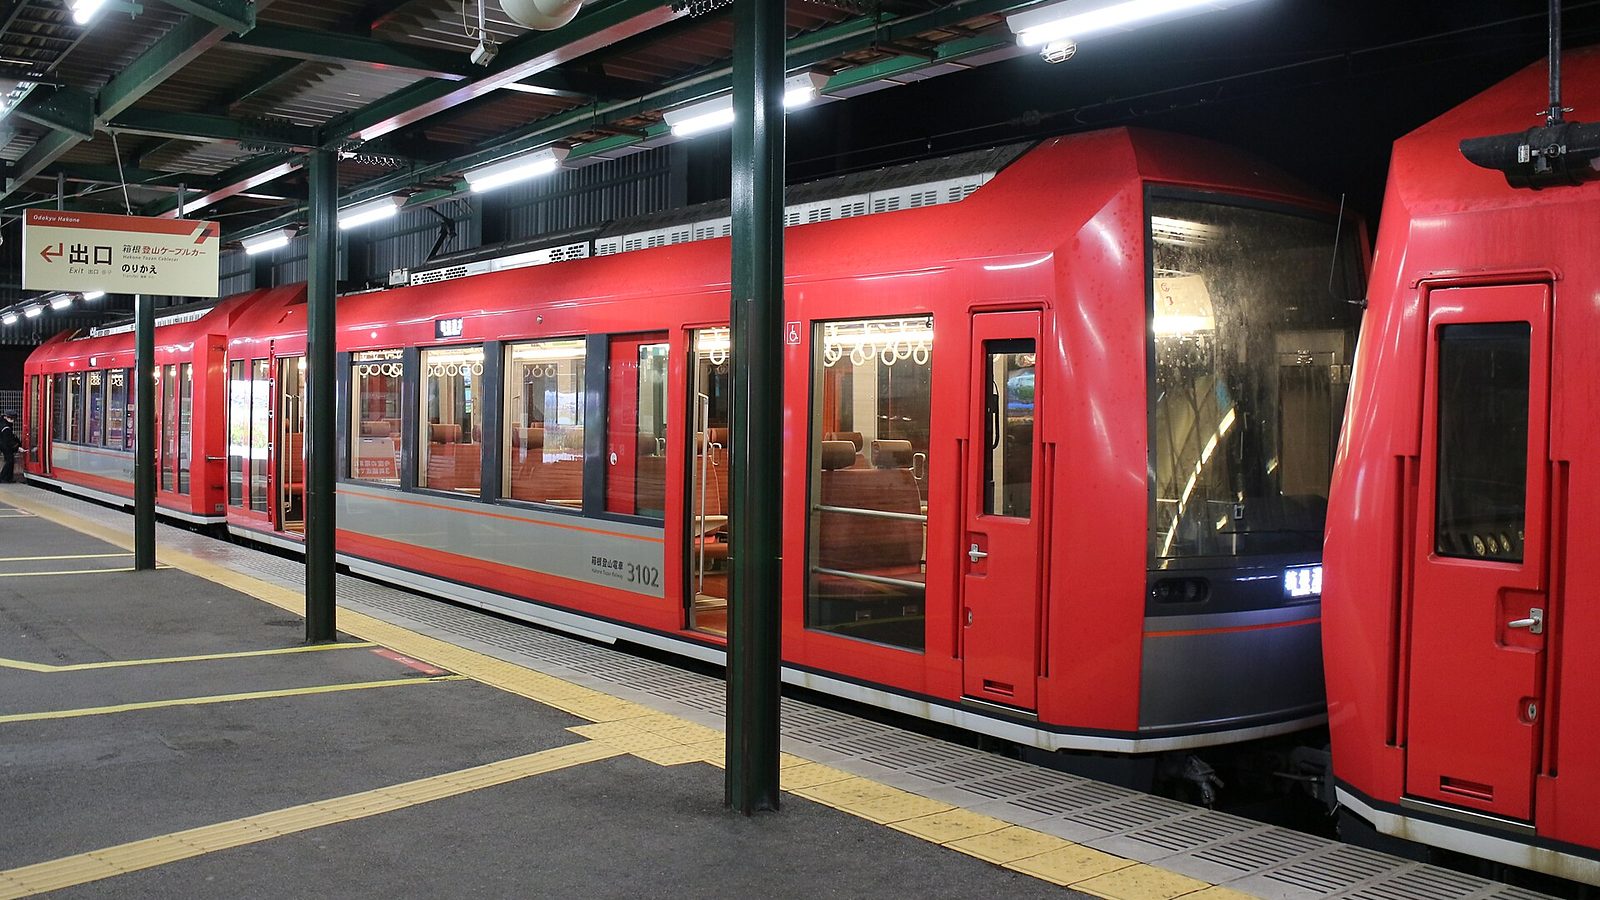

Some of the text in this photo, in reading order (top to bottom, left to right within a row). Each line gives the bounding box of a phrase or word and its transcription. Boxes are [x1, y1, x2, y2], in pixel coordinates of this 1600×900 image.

[70, 244, 112, 265] 出口
[123, 244, 206, 257] 箱根登山ケーブルカー
[121, 264, 157, 274] のりかえ
[627, 563, 658, 588] 3102
